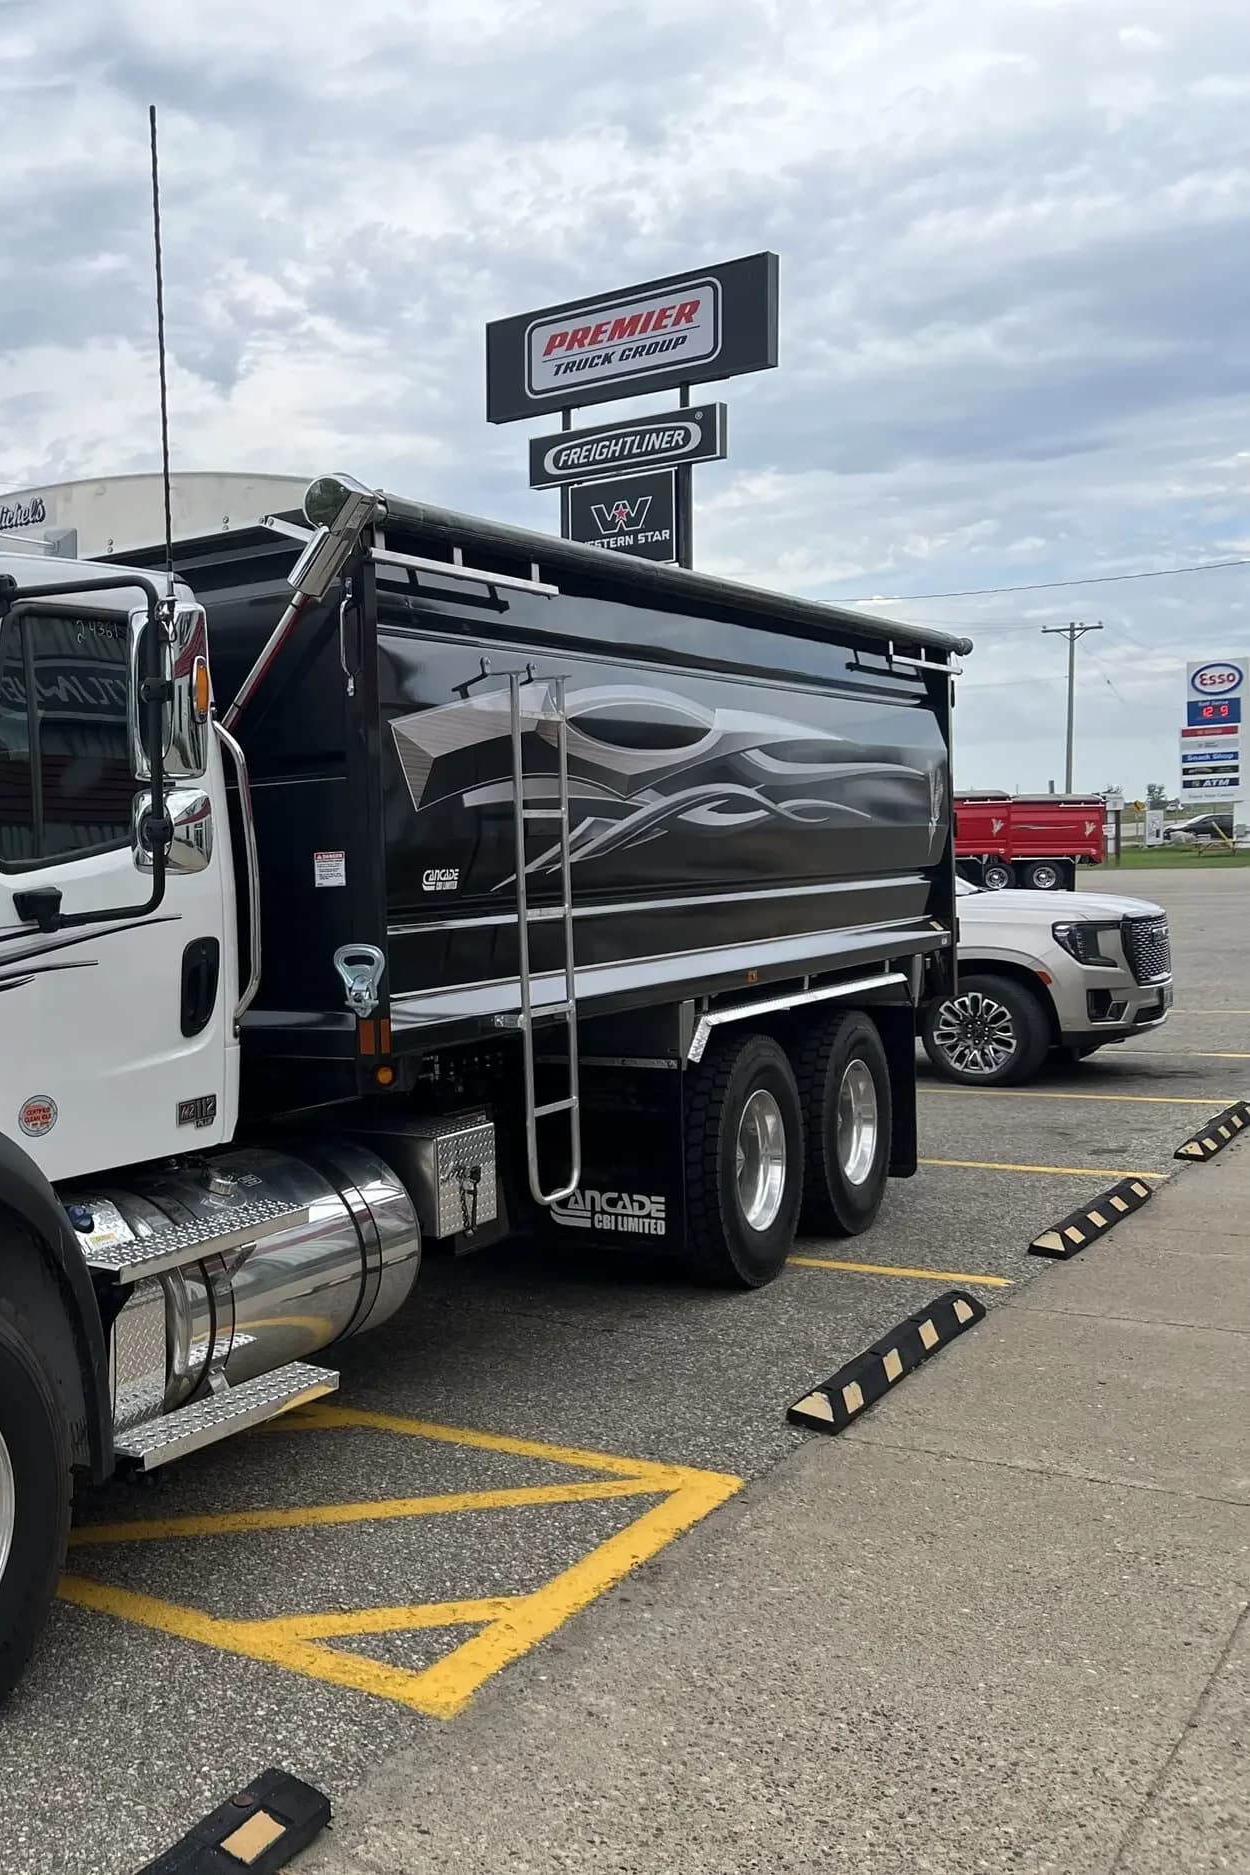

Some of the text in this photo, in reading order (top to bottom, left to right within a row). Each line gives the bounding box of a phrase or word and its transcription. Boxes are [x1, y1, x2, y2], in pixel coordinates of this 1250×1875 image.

[543, 299, 701, 357] PREMIER
[553, 335, 687, 376] TRUCK GROUP
[558, 429, 684, 467] FREIGHTLINER
[638, 529, 670, 544] STAR
[1203, 779, 1230, 787] ATM
[594, 1213, 666, 1235] CBI LIMITED
